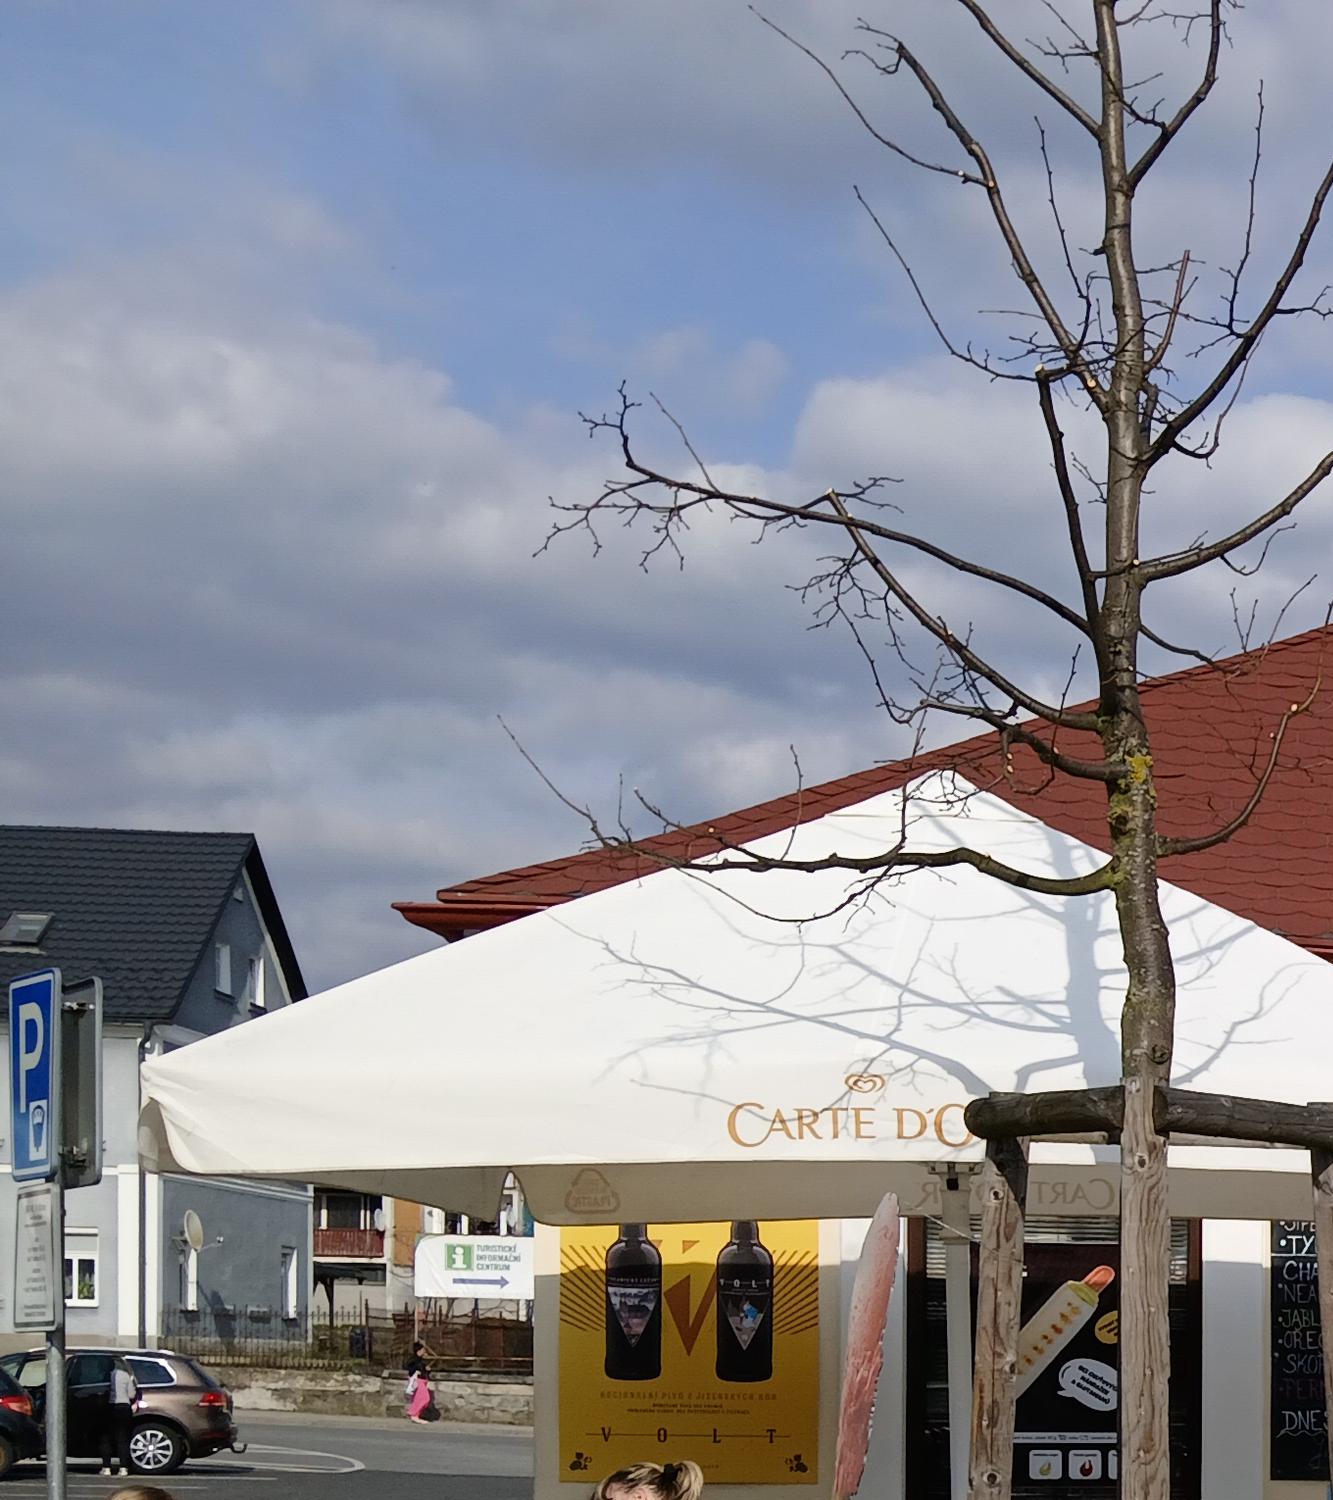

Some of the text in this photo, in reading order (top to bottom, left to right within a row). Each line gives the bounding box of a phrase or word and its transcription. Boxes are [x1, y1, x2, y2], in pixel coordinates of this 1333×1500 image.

[19, 1002, 43, 1113] P
[727, 1102, 975, 1148] CARTE D'O
